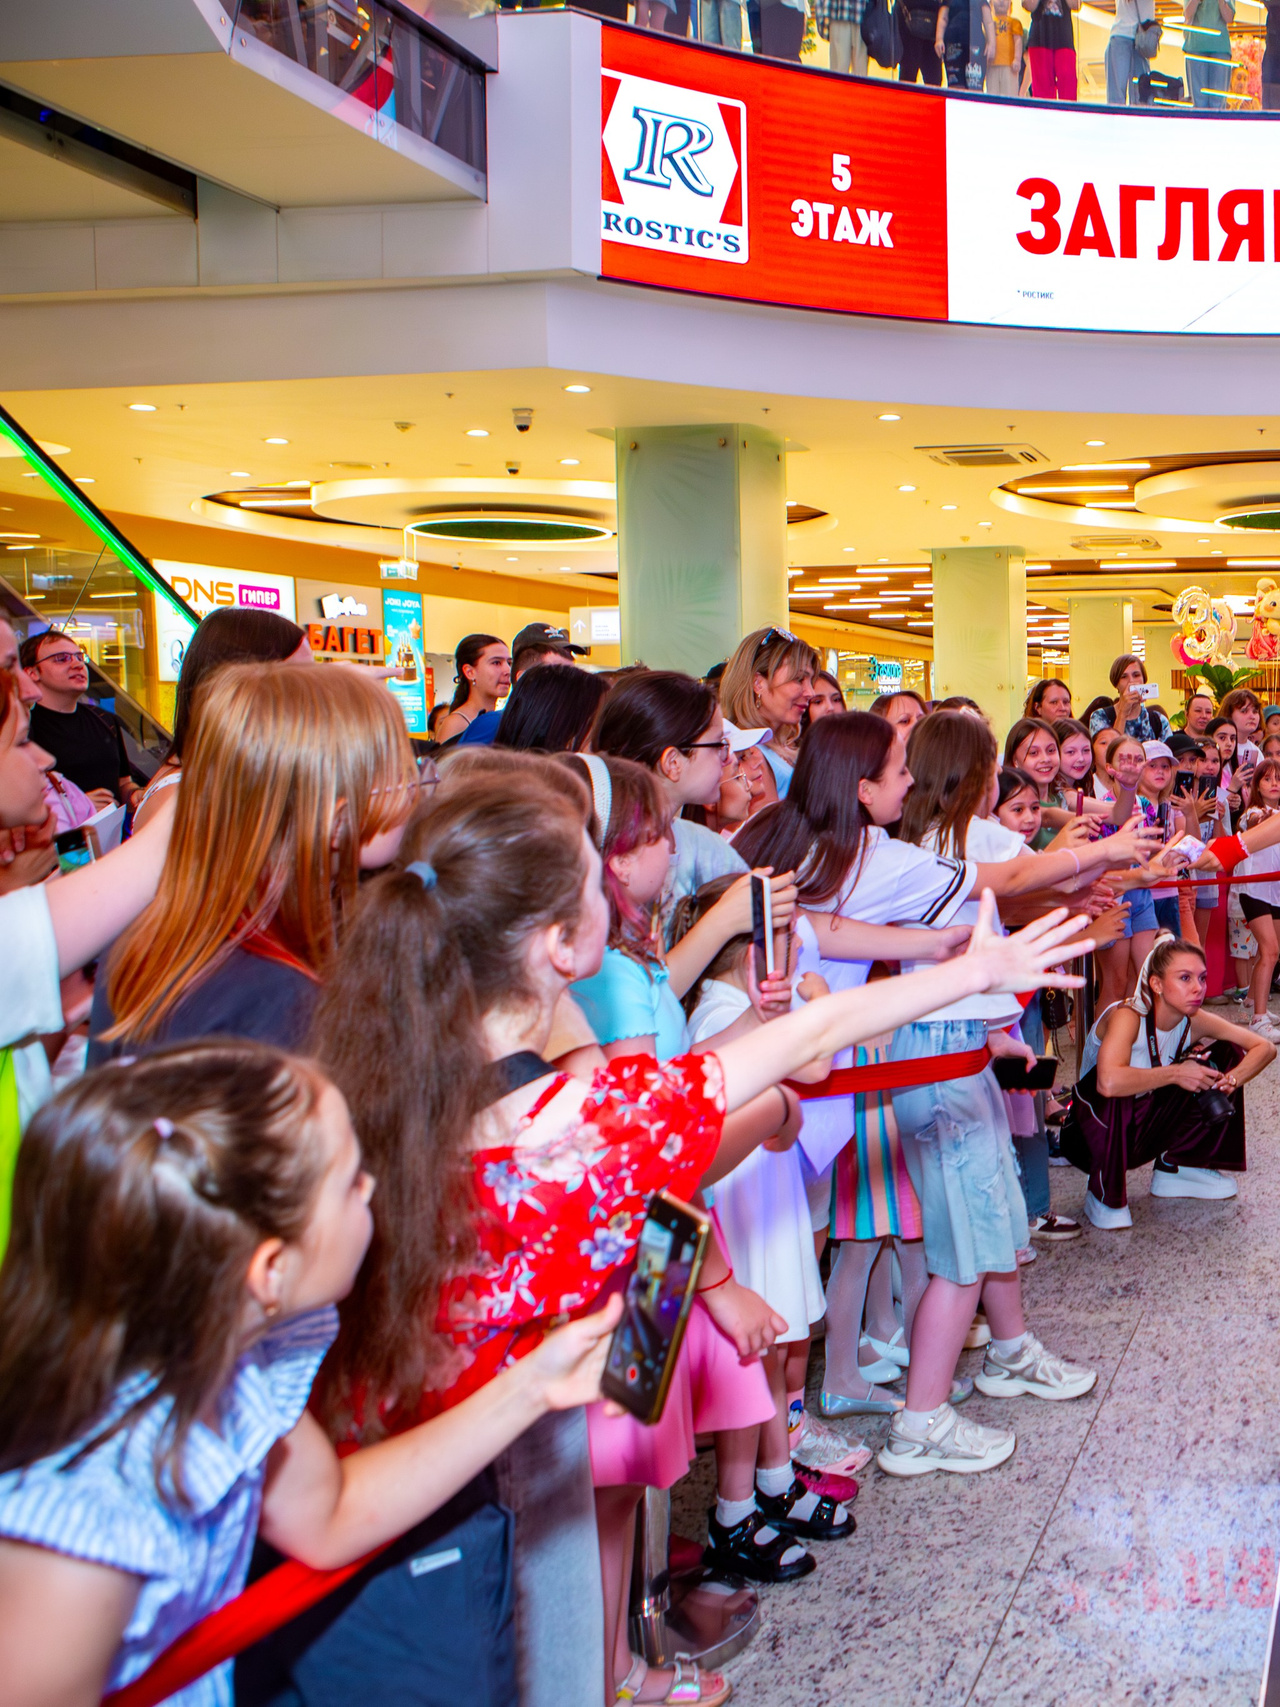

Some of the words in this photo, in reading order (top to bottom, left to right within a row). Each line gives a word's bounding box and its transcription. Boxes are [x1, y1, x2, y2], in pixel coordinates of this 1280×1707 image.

[624, 106, 714, 197] R
[831, 153, 852, 192] 5
[603, 210, 740, 253] ROSTIC'S
[790, 198, 894, 249] ЭТАЖ
[171, 576, 235, 606] DNS
[241, 588, 278, 606] ГИПЕР
[402, 599, 421, 609] JOYA
[308, 623, 383, 654] БАГЕТ
